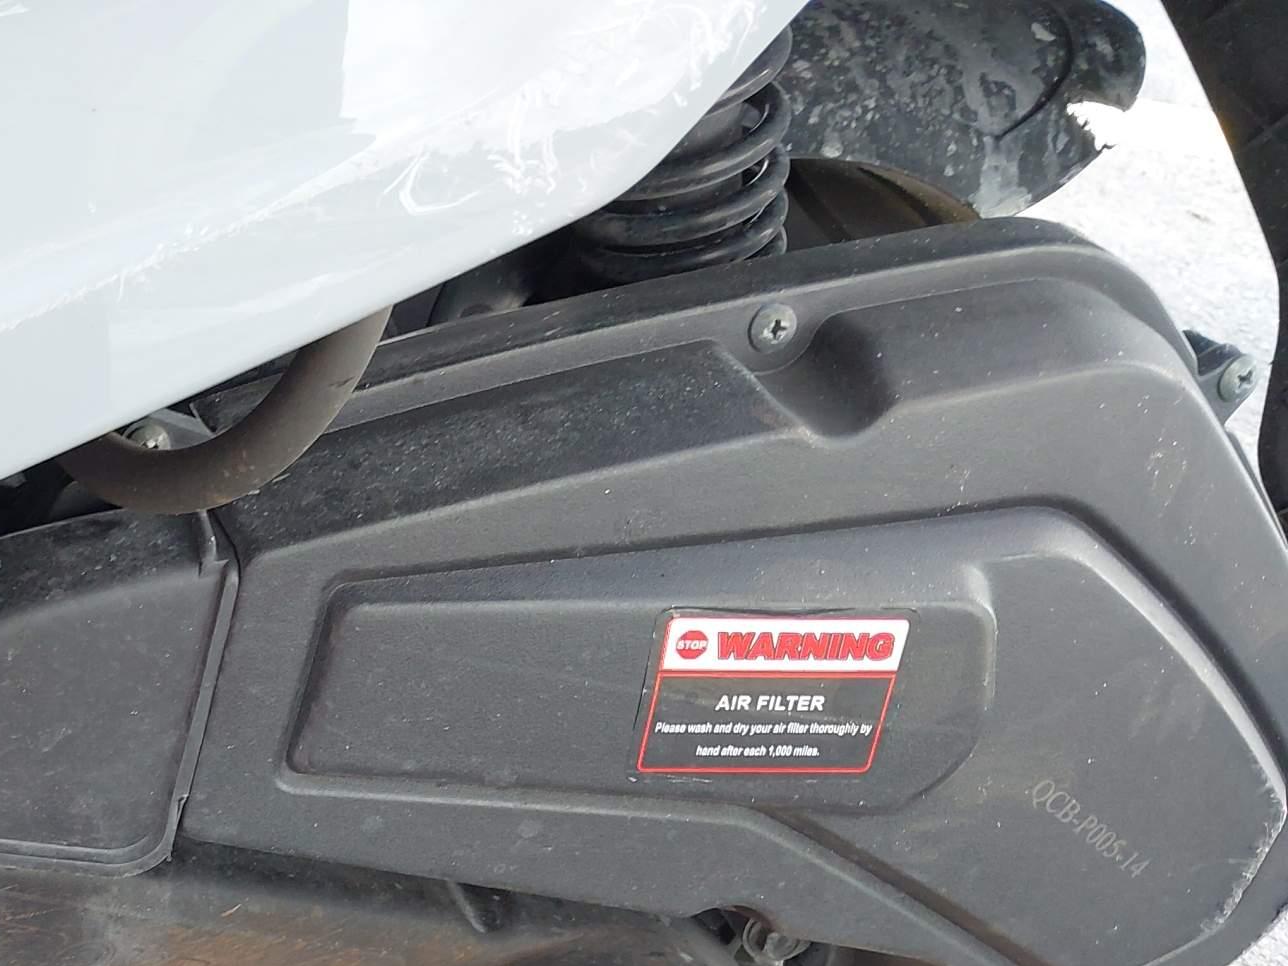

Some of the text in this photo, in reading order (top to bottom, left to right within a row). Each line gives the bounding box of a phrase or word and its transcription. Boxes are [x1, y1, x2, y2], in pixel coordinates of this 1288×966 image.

[676, 631, 896, 661] STOP WARNING
[715, 695, 825, 711] AIR FILTER
[655, 722, 872, 736] Please wash and dry your air filter thoroughly by
[696, 745, 819, 757] hand after each 1,000 miles.
